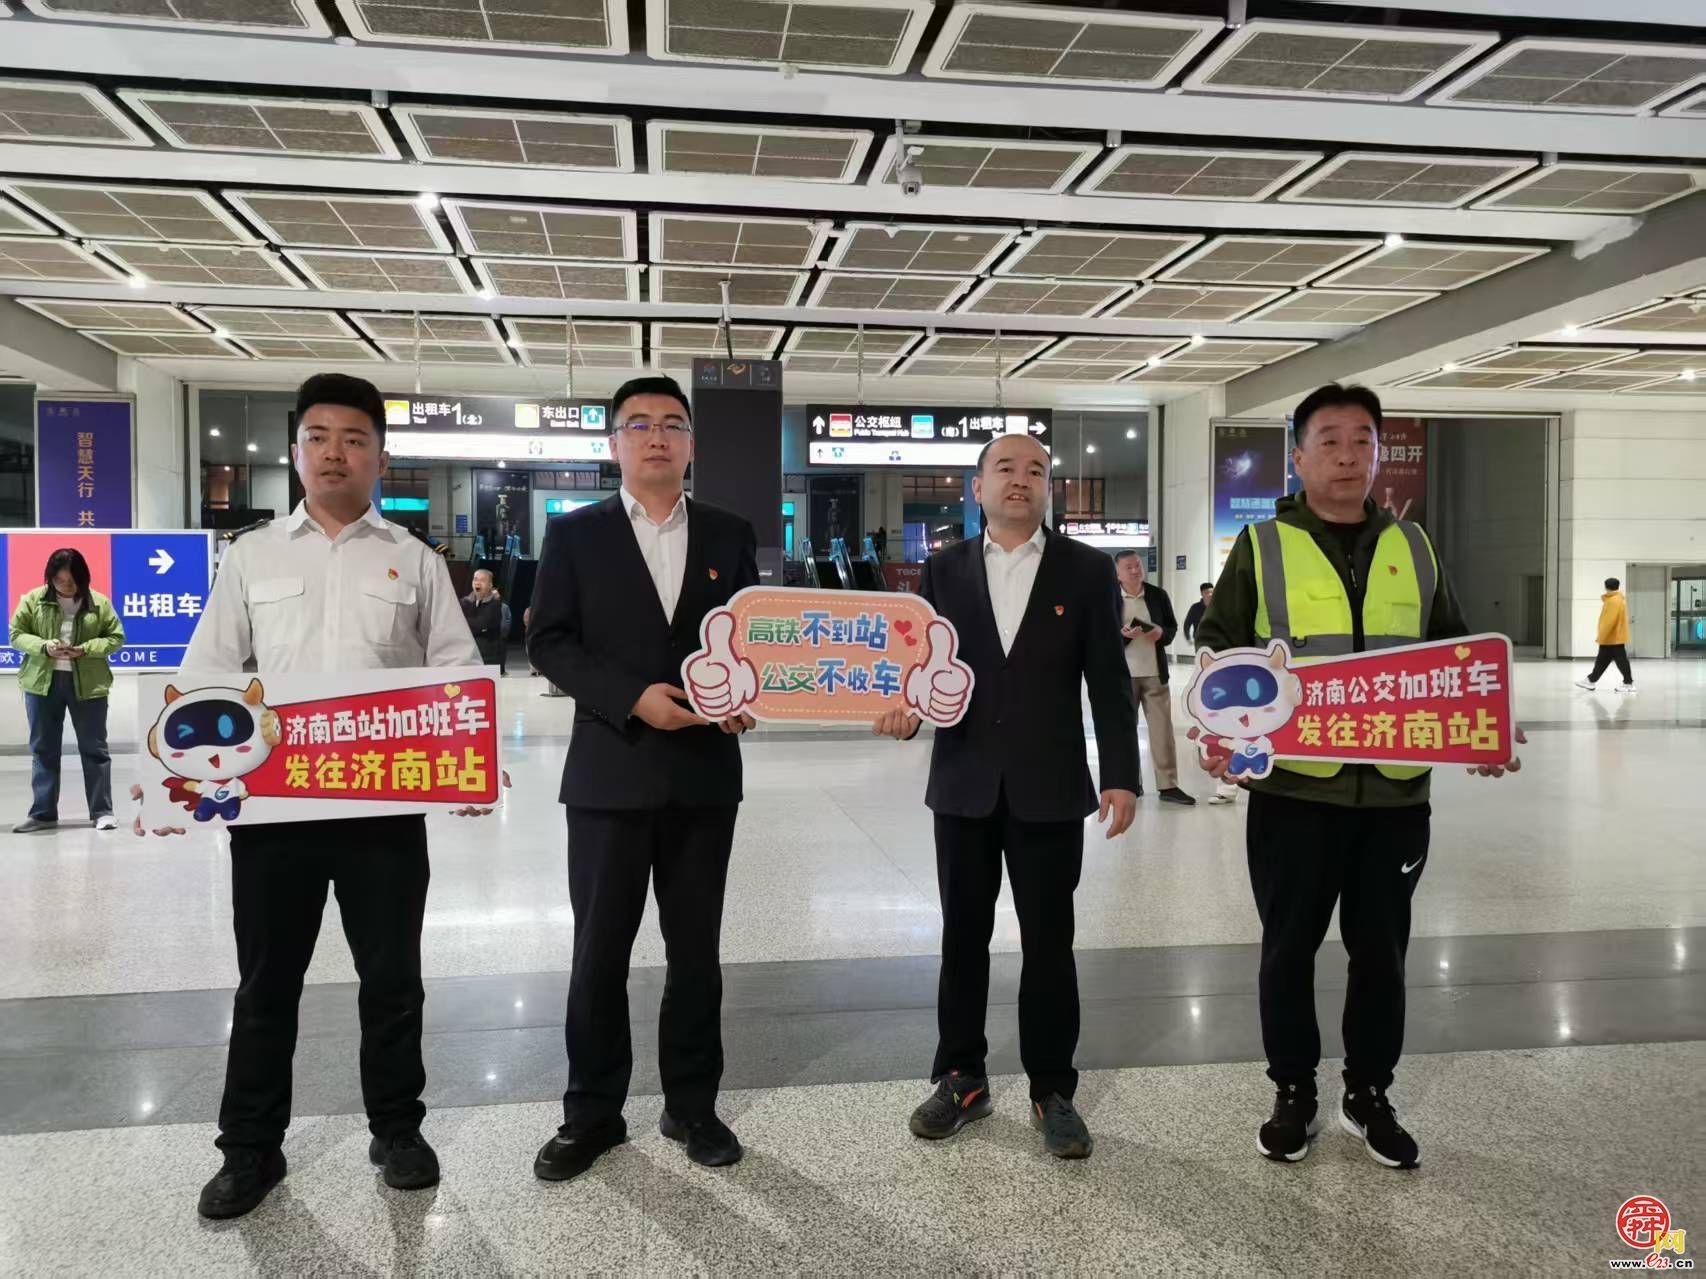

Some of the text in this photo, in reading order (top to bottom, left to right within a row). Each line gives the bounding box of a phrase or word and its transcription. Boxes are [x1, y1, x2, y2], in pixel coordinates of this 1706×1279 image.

[542, 405, 579, 419] 东出口
[855, 415, 902, 428] 公交枢纽
[77, 432, 95, 528] 智慧天行 共
[123, 592, 203, 618] 出租车
[748, 610, 888, 650] 高铁不到站
[760, 659, 901, 697] 公交不收车
[1306, 660, 1501, 707] 济南公交加班车
[286, 695, 490, 746] 济南西站加班车
[1297, 708, 1500, 751] 发往济南站
[285, 746, 487, 792] 发往济南站
